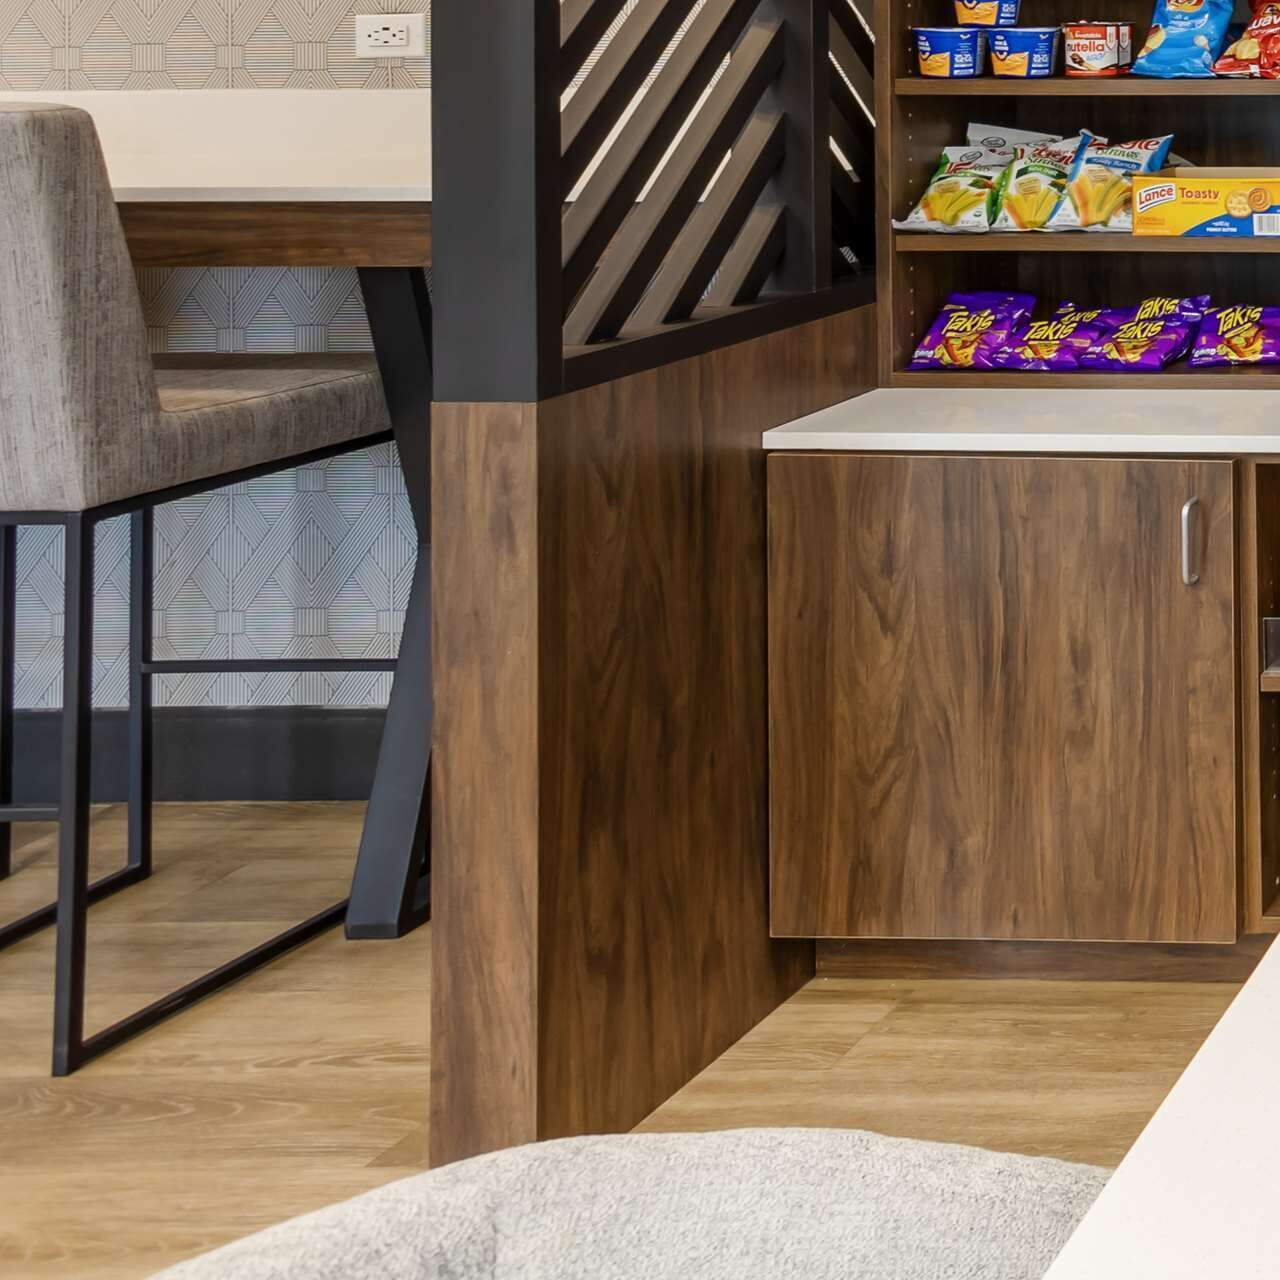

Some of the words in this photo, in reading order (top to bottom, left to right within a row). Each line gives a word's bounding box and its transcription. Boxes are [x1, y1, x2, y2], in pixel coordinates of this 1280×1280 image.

[1067, 40, 1104, 53] nutella
[1138, 187, 1175, 206] Lance
[1179, 187, 1220, 200] Toasty
[1134, 297, 1180, 322] Takis
[941, 311, 996, 335] Takis
[1023, 321, 1077, 340] Takis
[1216, 307, 1263, 335] Takis
